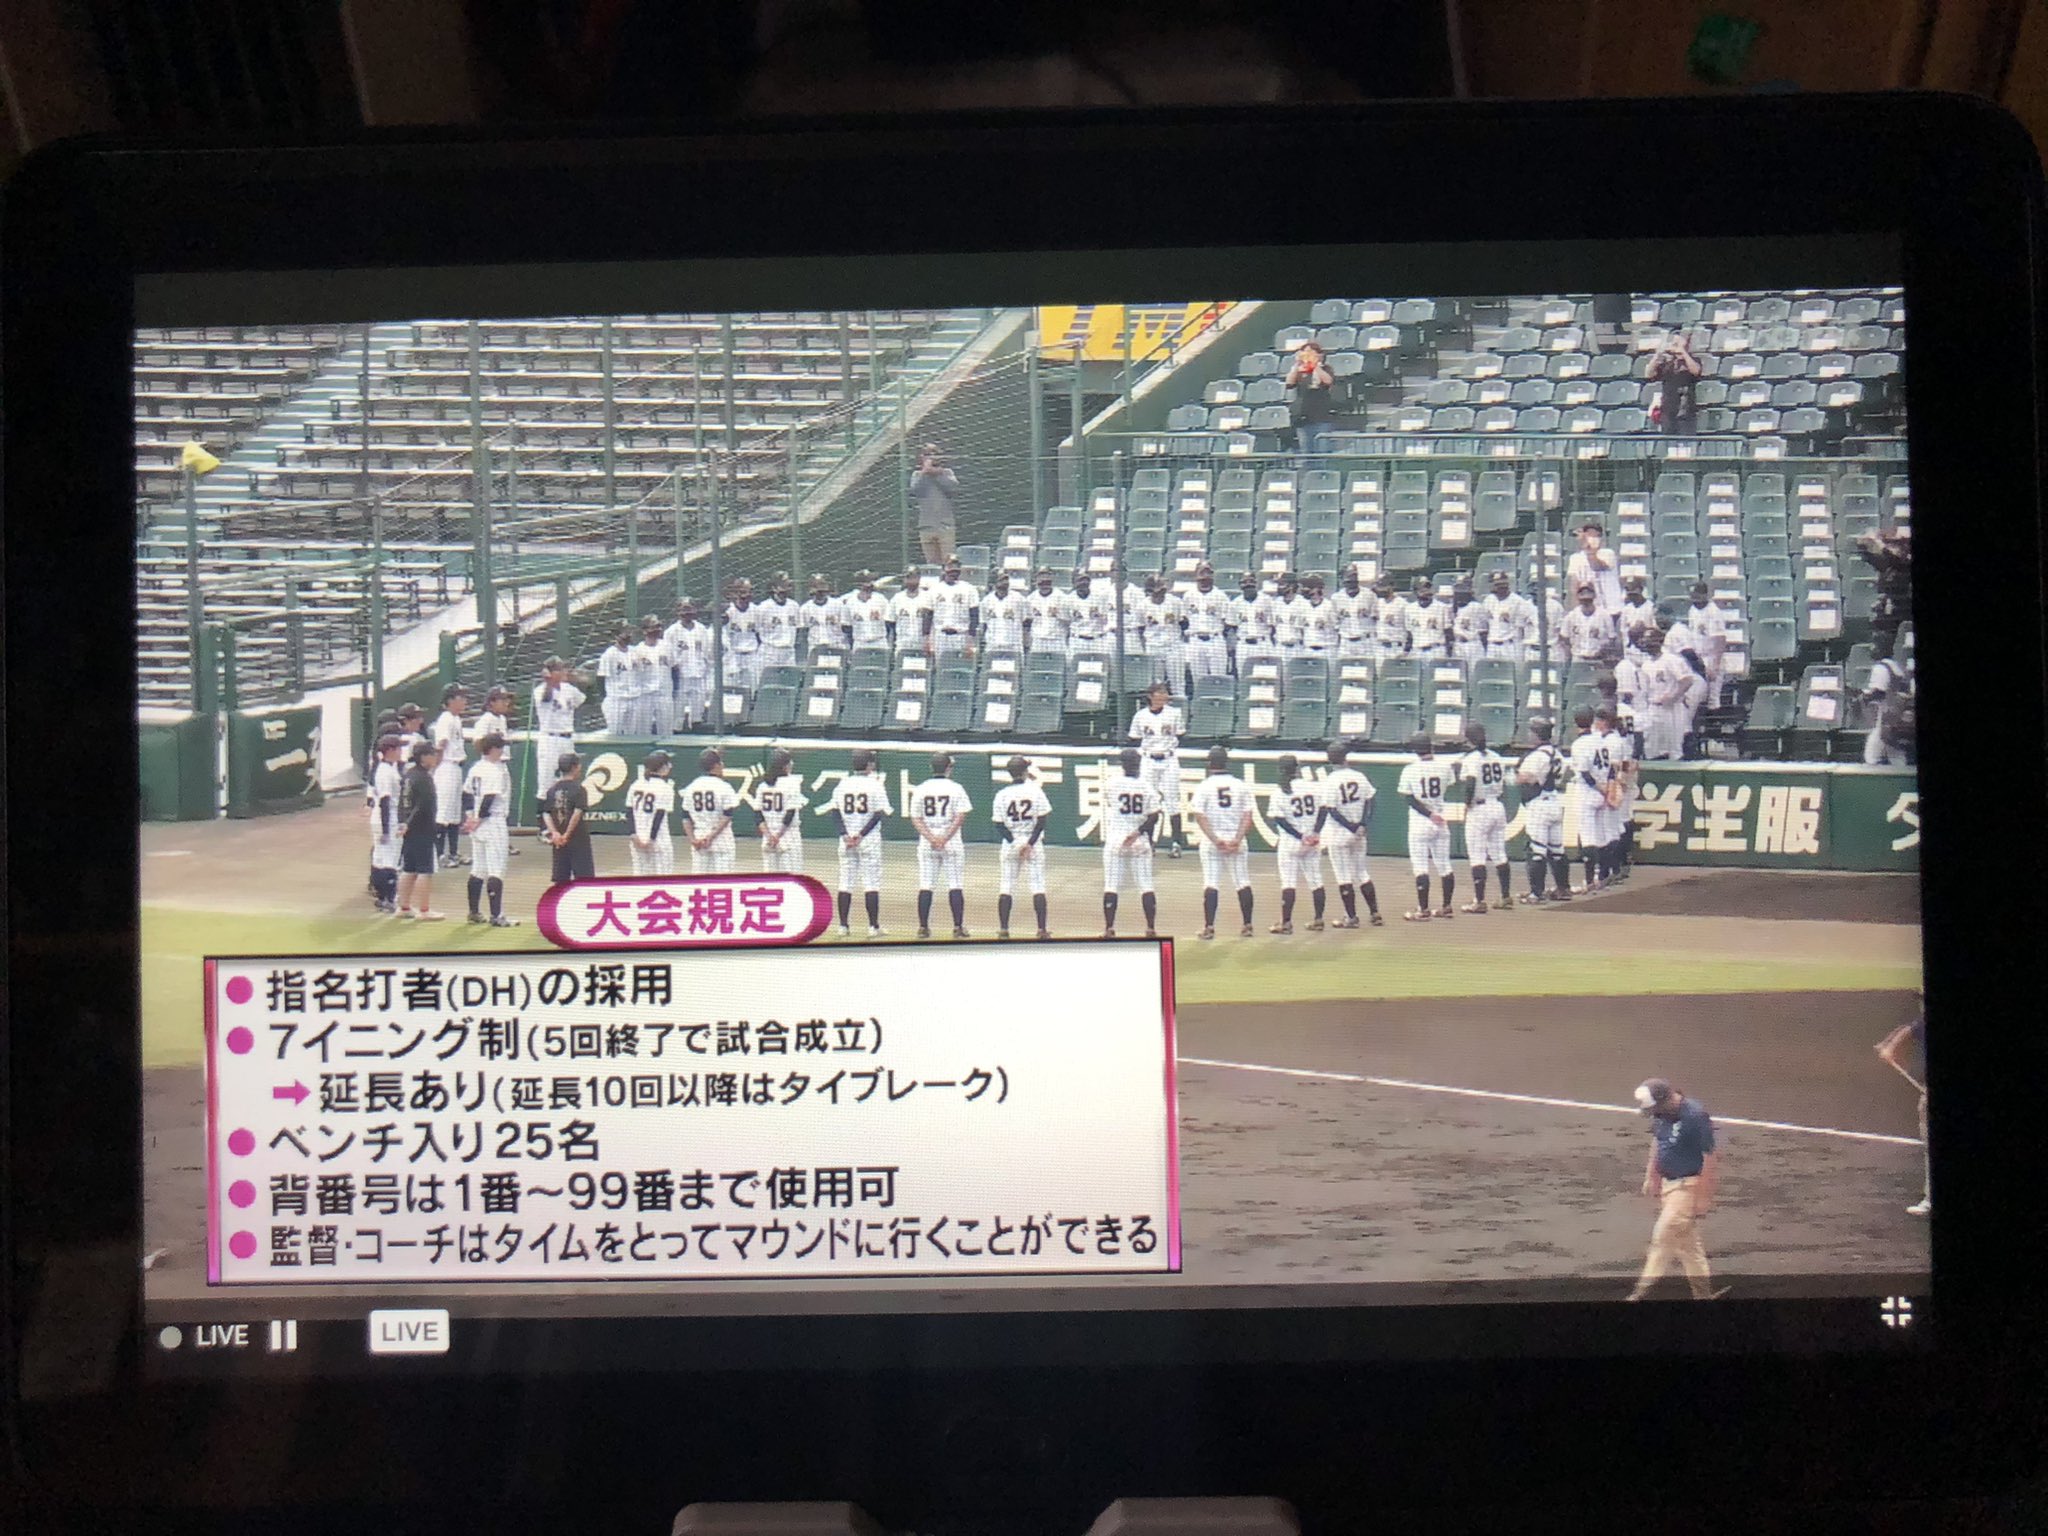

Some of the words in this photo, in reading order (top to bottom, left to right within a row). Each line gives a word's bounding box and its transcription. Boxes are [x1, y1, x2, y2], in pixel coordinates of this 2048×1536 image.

[1593, 747, 1610, 771] 49
[1481, 762, 1503, 785] 89
[1217, 786, 1232, 808] 5
[1339, 781, 1359, 804] 12
[1419, 776, 1441, 799] 18
[761, 791, 783, 812] 50
[843, 792, 868, 815] 83
[923, 795, 950, 818] 87
[1006, 798, 1032, 822] 42
[1118, 793, 1144, 815] 36
[1290, 794, 1316, 818] 39
[586, 887, 786, 936] 大会規定
[266, 964, 673, 1013] 指名打者(DH)の採用
[269, 1016, 883, 1063] 7イニング制(5回終了で試合成立)
[319, 1066, 1010, 1114] 延長あり(延長10回以降はタイブレーク)
[268, 1119, 600, 1163] ベンチ入り25名
[197, 1323, 249, 1347] LIVE
[382, 1321, 440, 1343] LIVE
